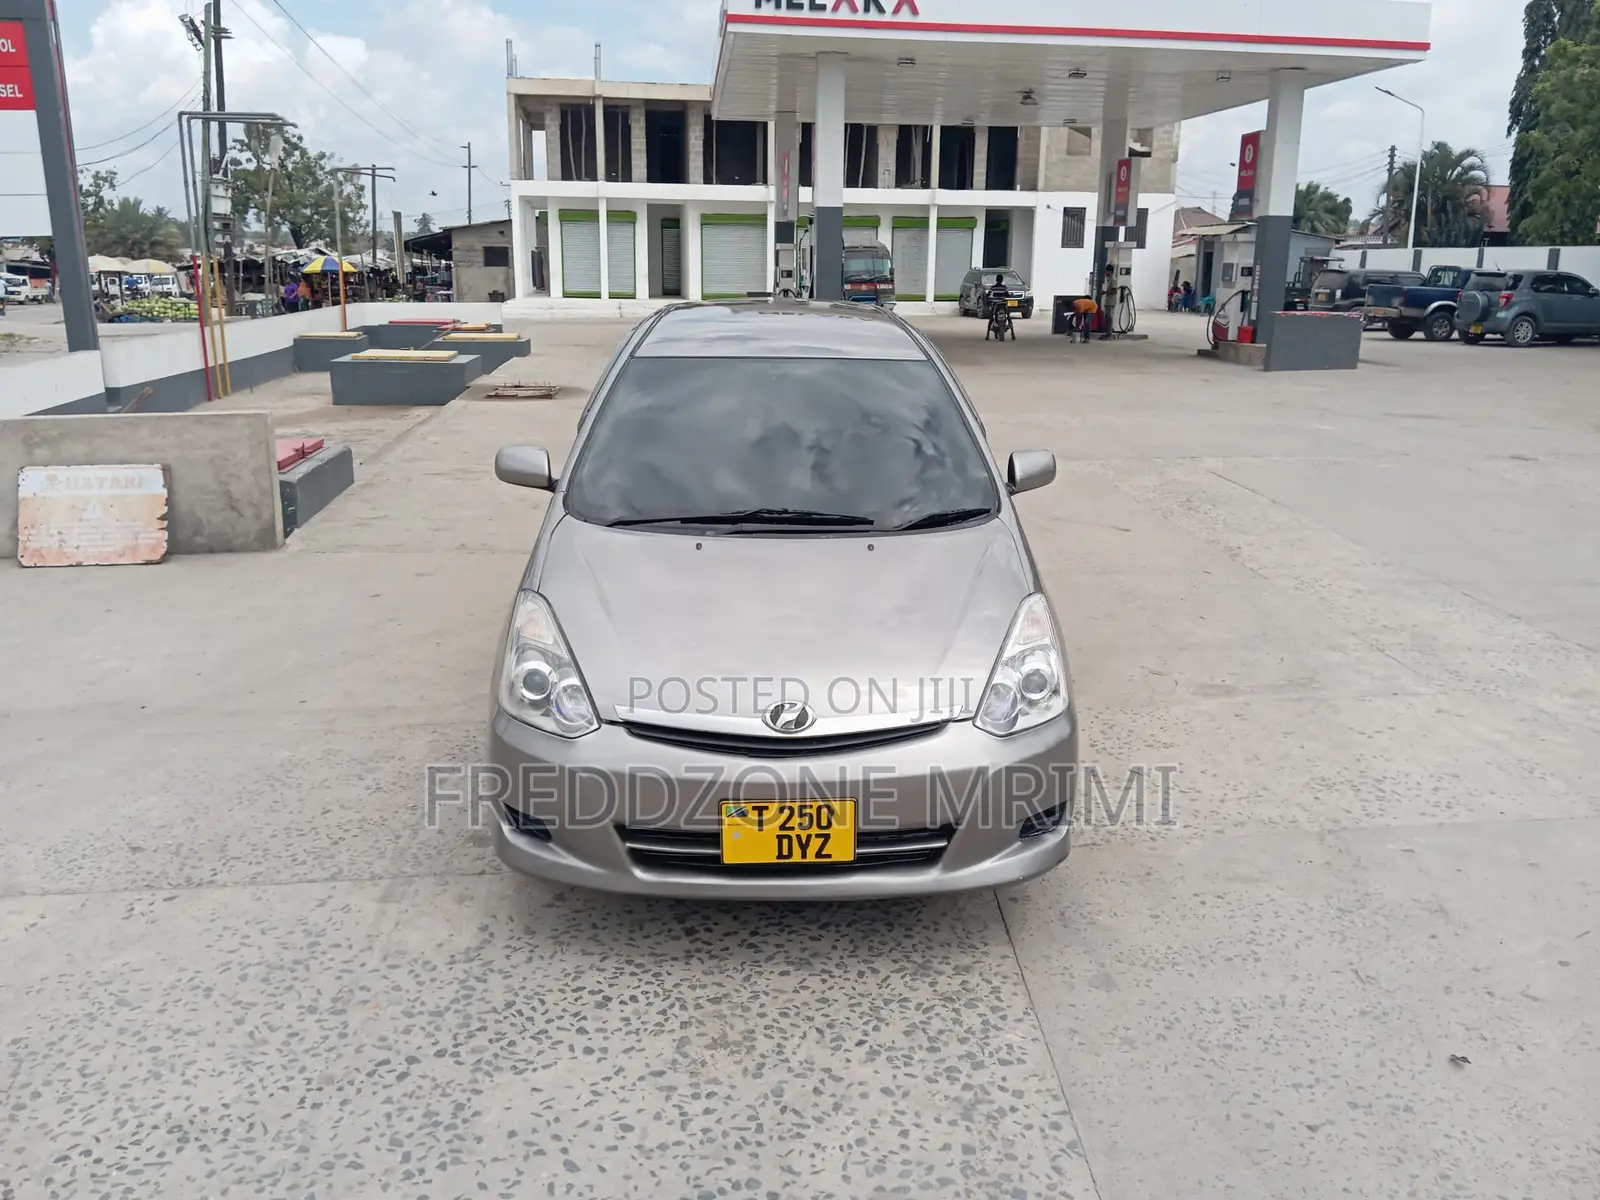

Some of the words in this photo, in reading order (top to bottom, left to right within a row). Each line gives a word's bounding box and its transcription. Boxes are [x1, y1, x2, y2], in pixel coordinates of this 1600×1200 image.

[751, 805, 769, 832] T
[778, 804, 835, 832] 250
[775, 832, 833, 861] DYZ
